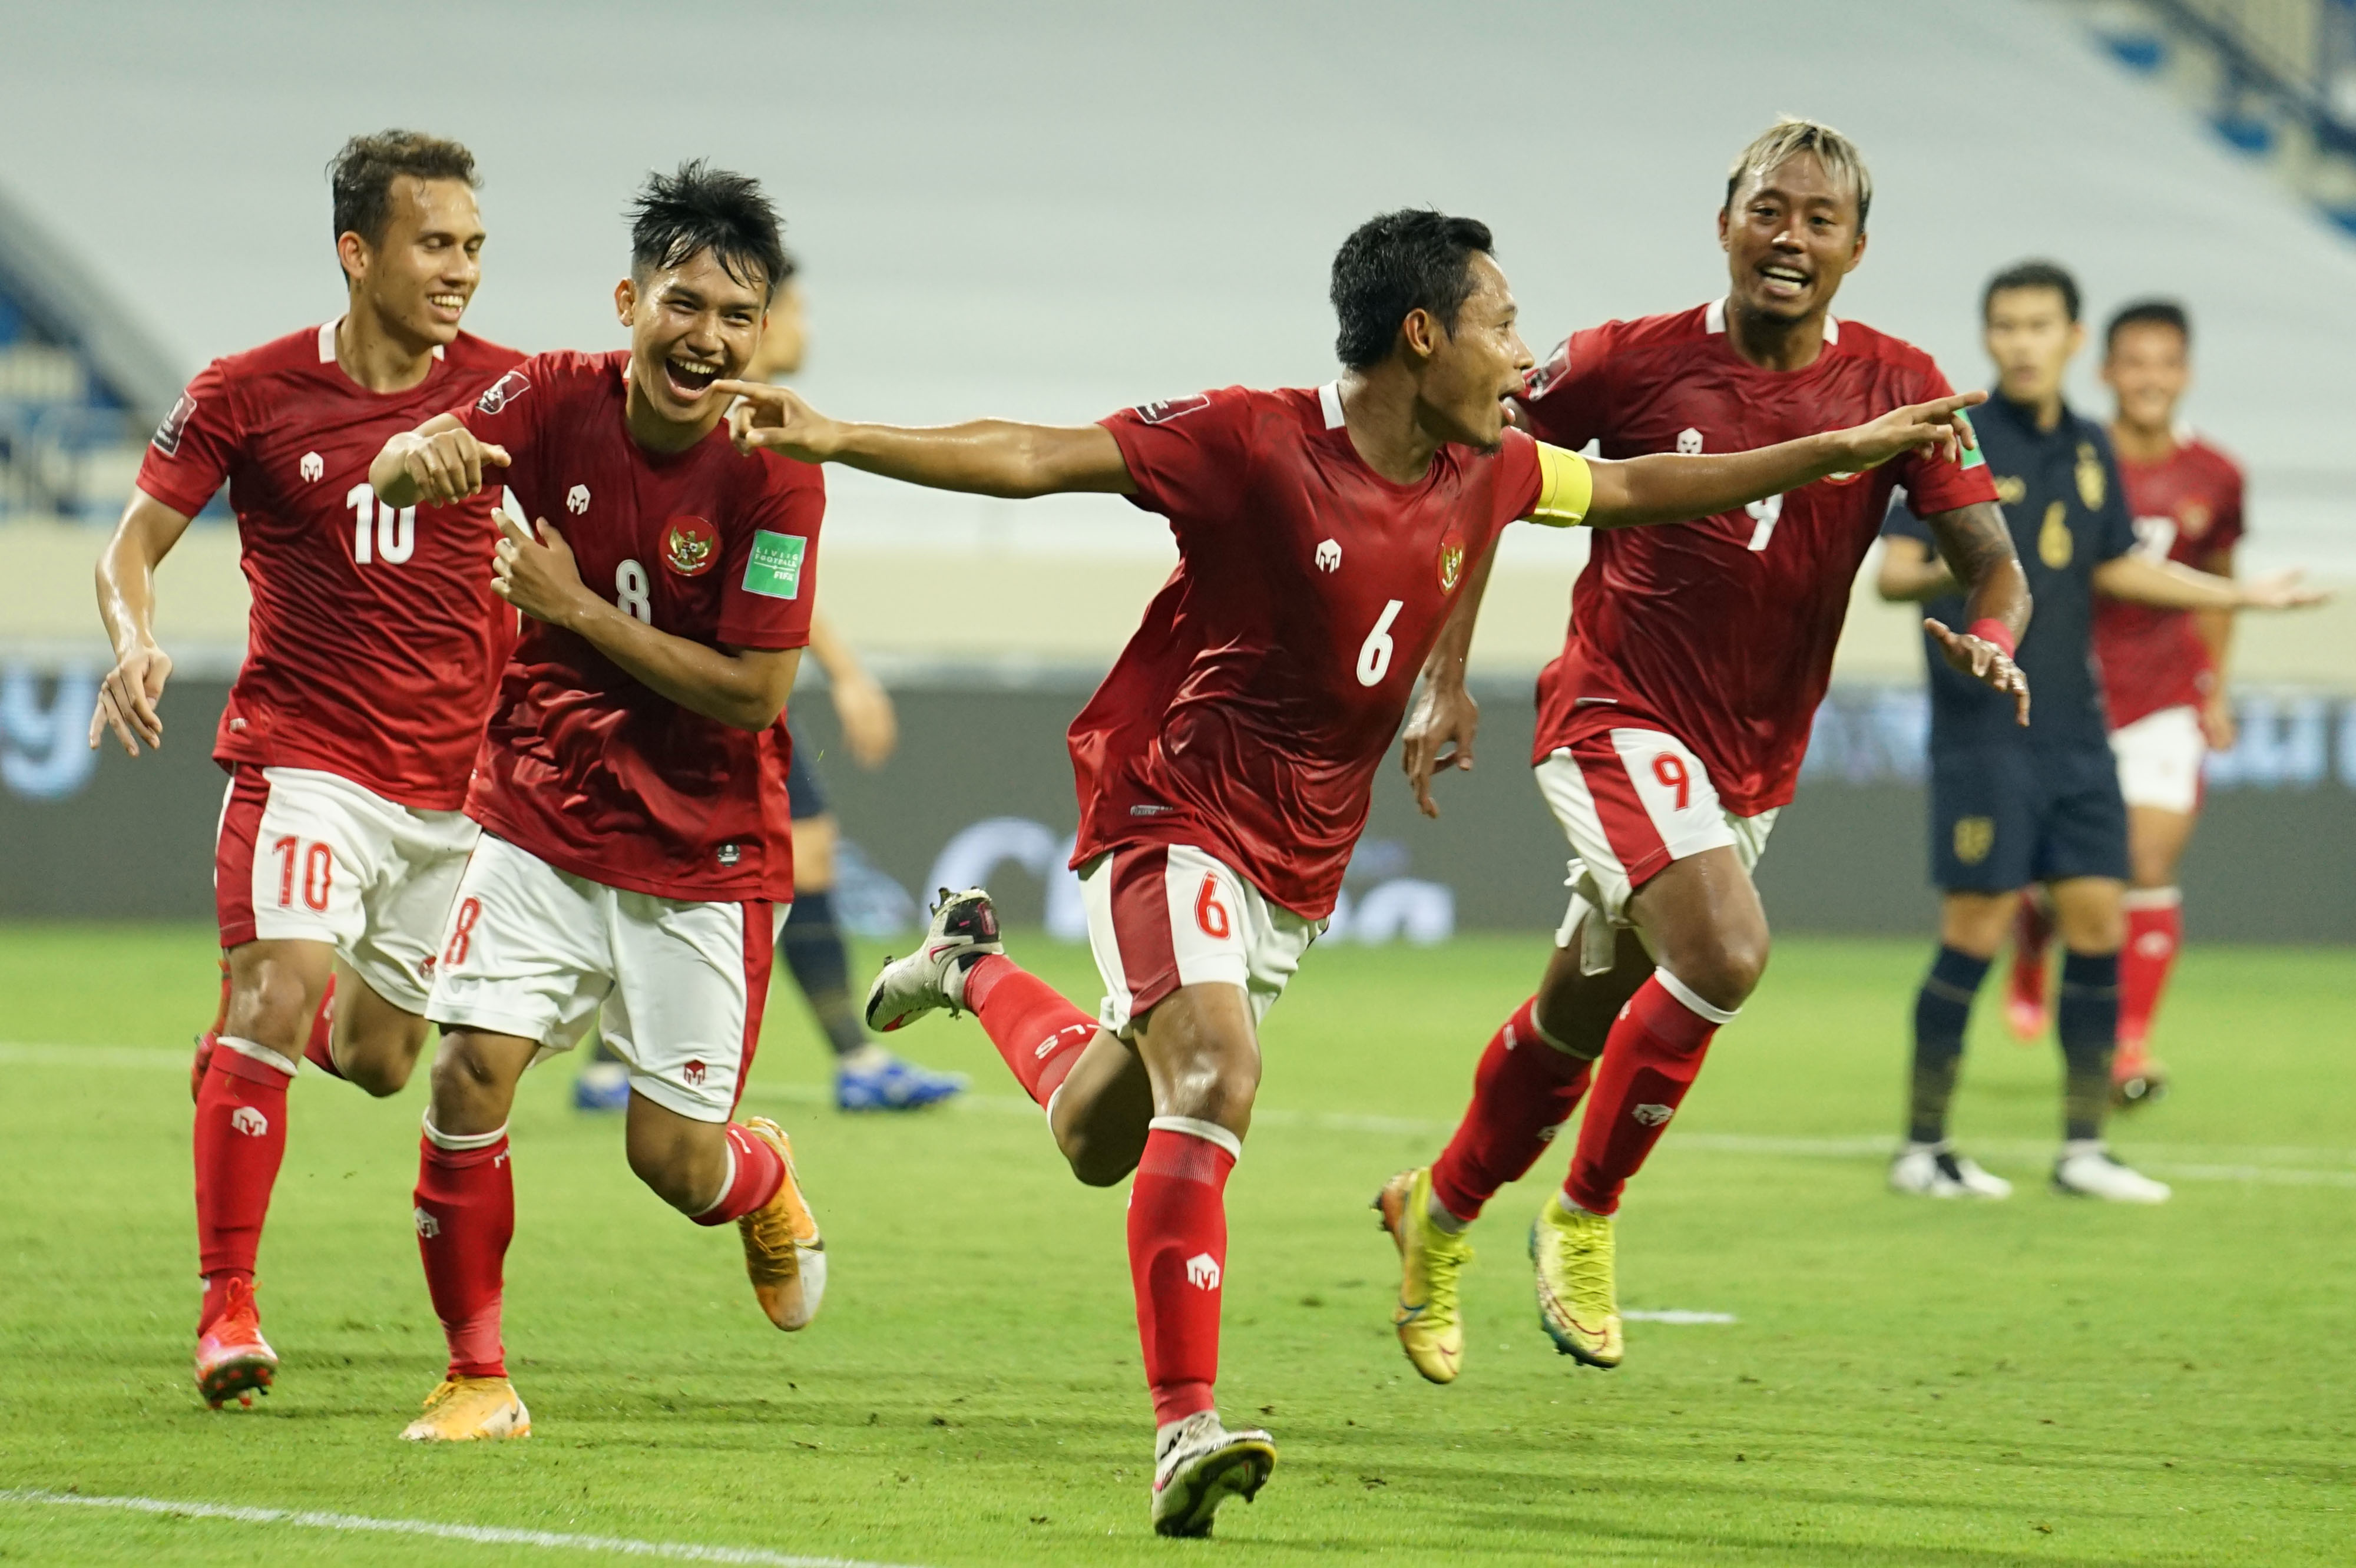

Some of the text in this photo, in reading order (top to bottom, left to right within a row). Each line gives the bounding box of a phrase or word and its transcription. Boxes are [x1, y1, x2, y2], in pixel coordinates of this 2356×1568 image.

[346, 483, 416, 564] 10
[616, 559, 651, 626] 8
[773, 571, 795, 582] FIFA
[1356, 599, 1404, 687] 6
[1652, 751, 1690, 811] 9
[272, 834, 332, 912] 10
[1194, 871, 1231, 941] 6
[442, 896, 482, 972] 8
